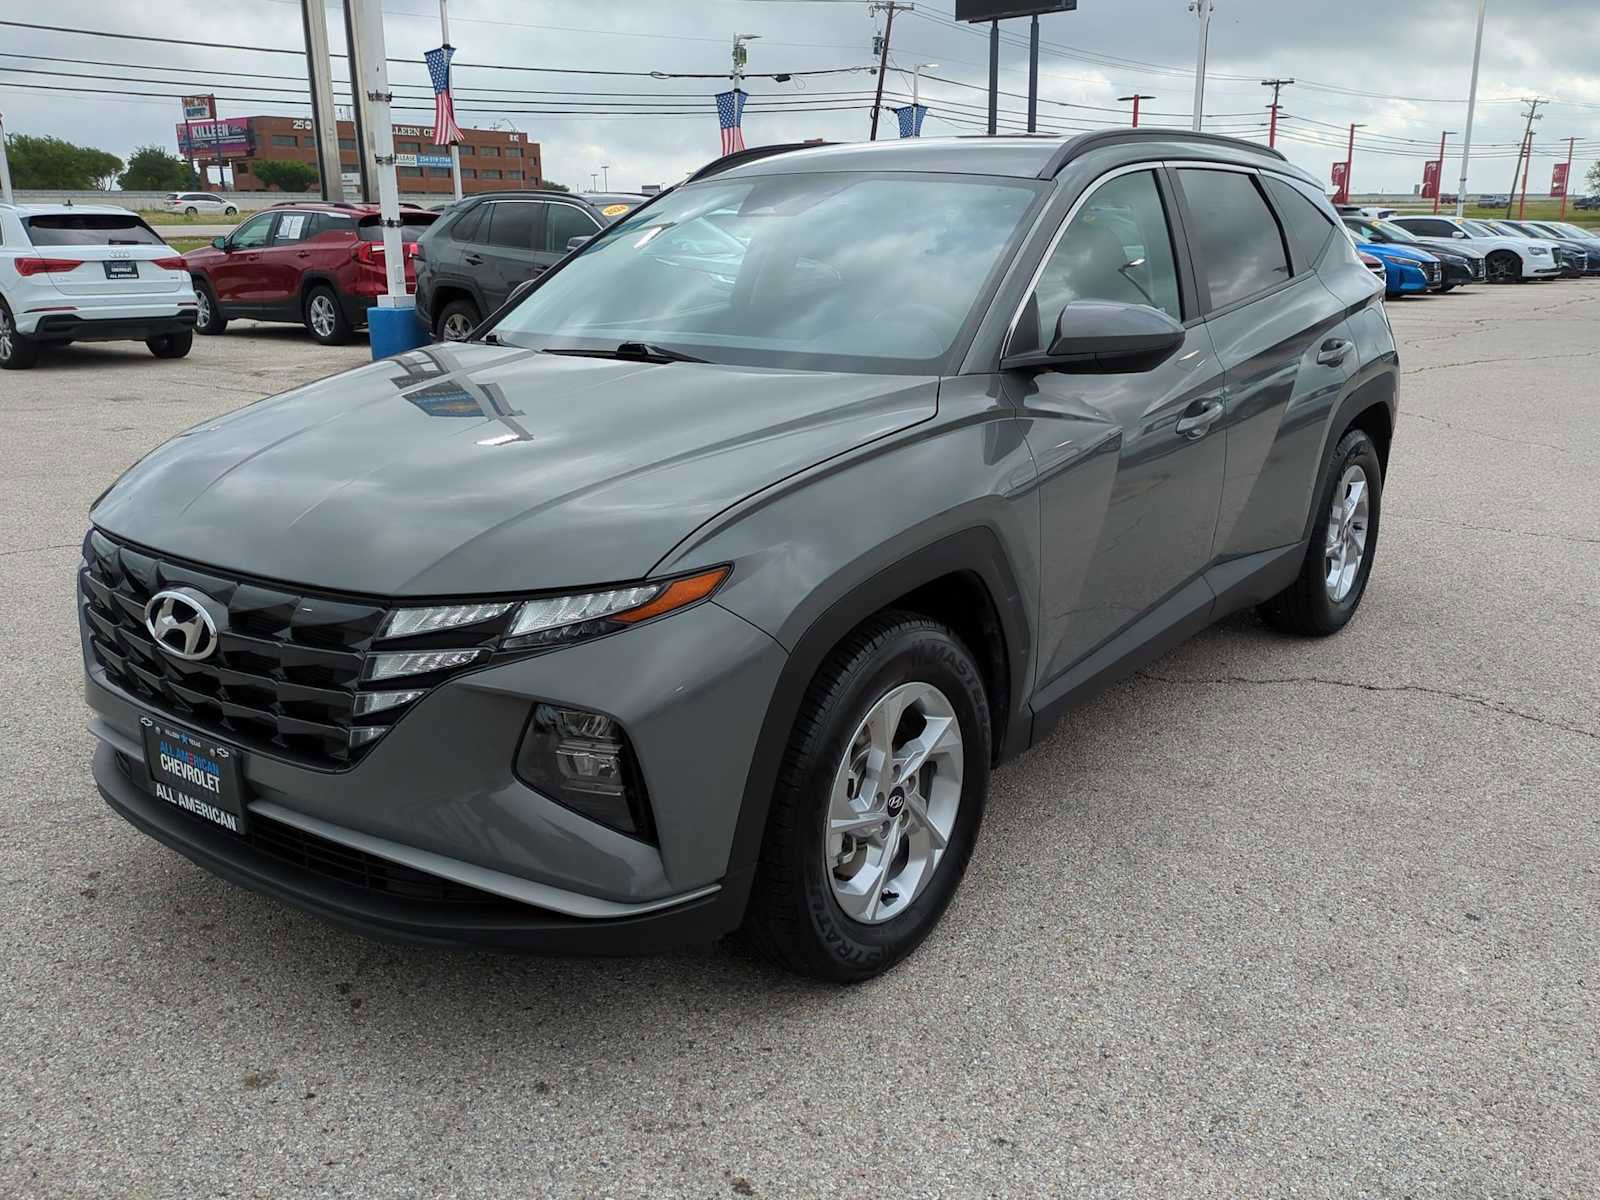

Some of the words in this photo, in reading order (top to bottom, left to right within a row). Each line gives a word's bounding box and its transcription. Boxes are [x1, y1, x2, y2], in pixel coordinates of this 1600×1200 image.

[191, 123, 229, 139] KILLEEN
[160, 753, 220, 794] CHEVROLET
[176, 747, 220, 776] AMERICAN
[156, 783, 177, 804] ALL
[178, 791, 237, 832] AMERICAN
